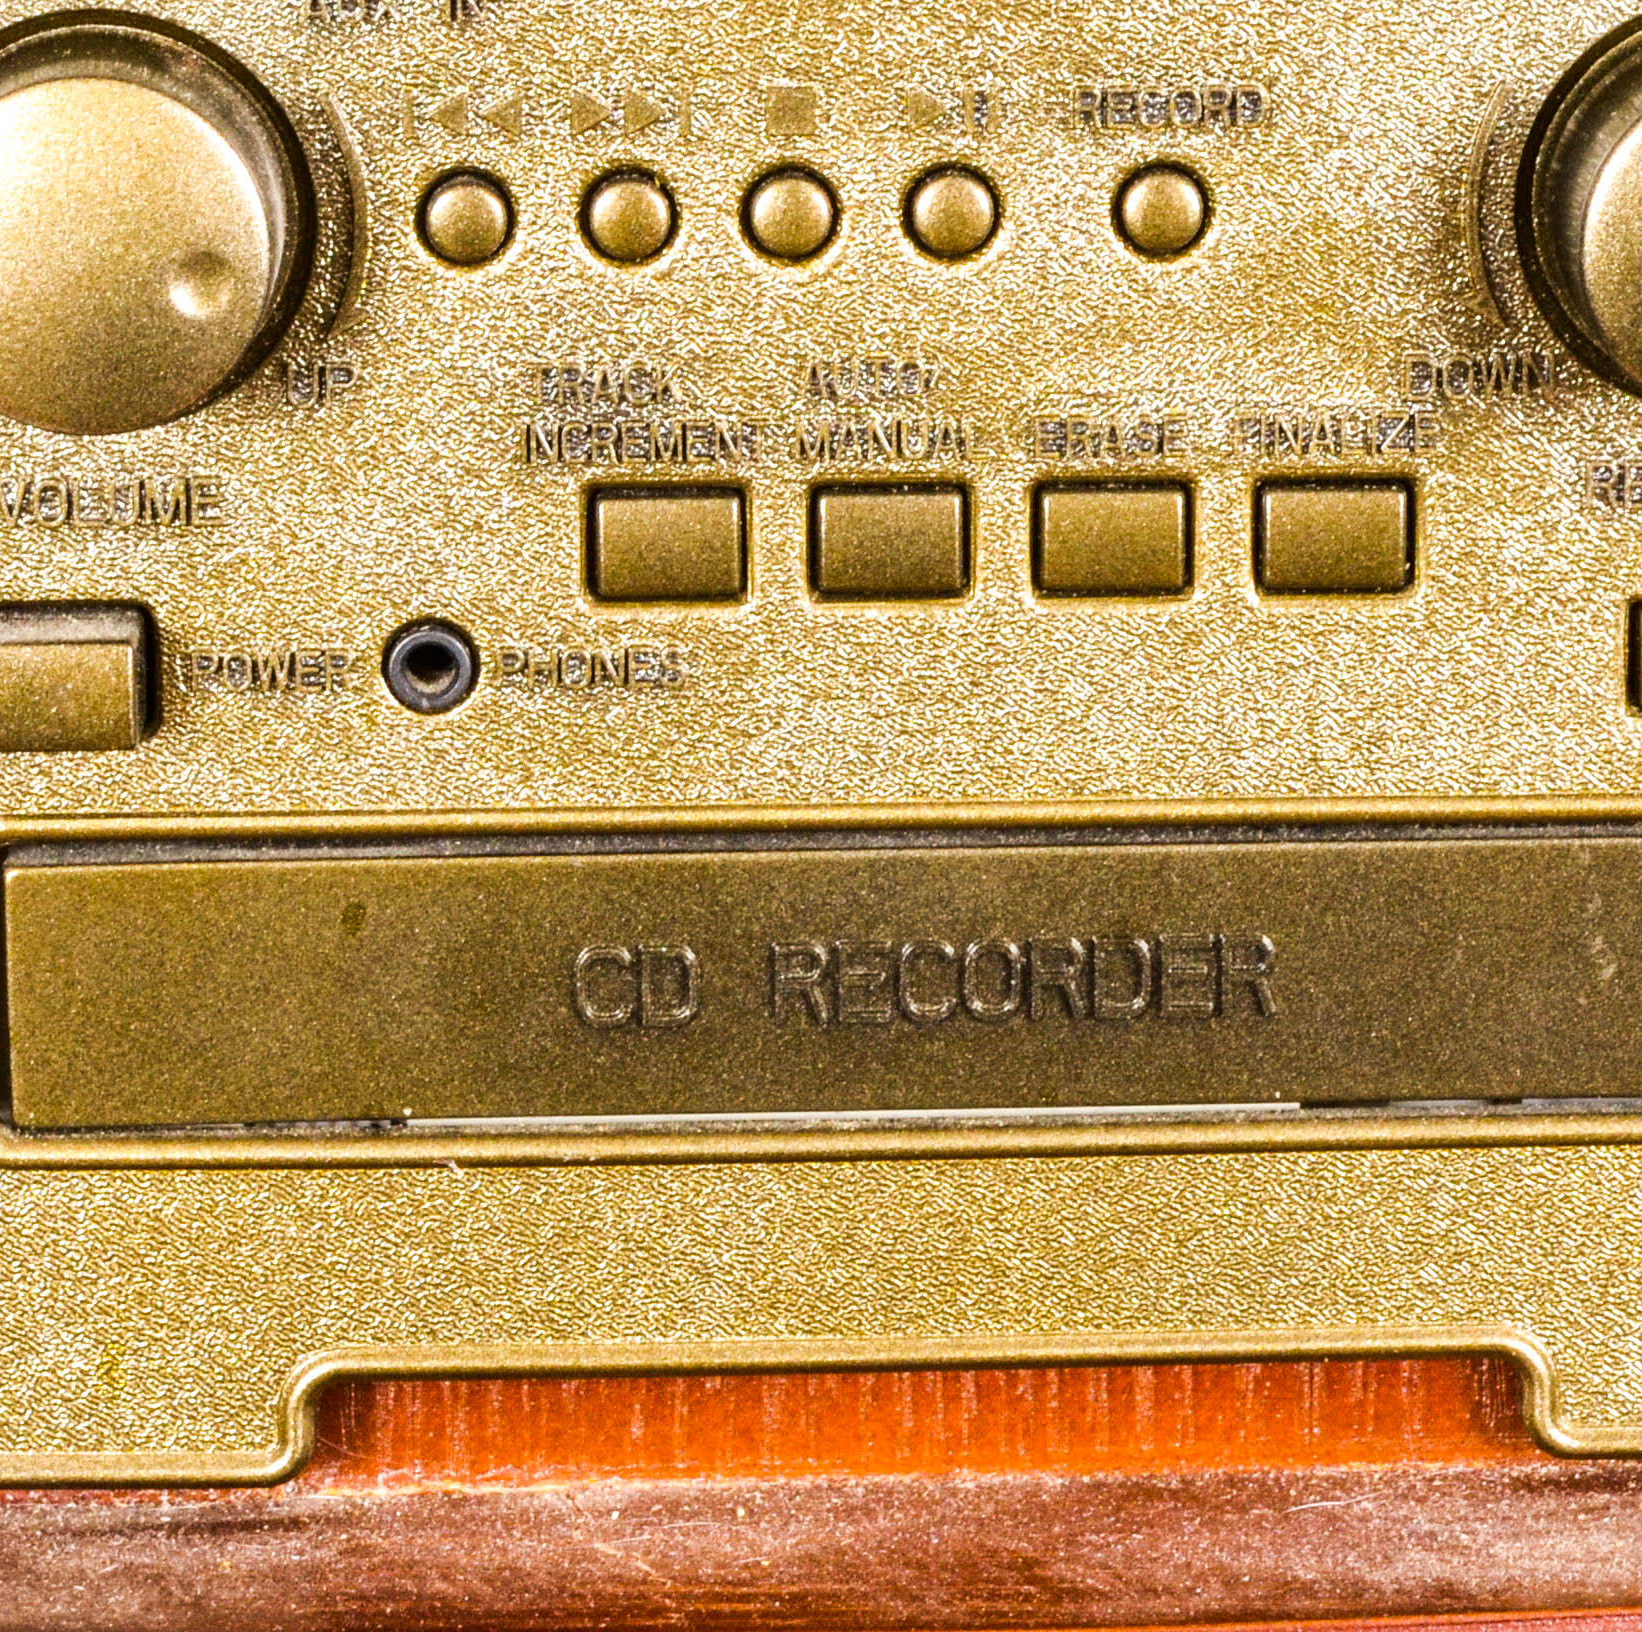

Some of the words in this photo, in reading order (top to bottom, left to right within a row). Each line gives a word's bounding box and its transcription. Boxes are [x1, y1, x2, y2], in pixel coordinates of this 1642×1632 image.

[1075, 85, 1273, 129] RECORD
[285, 368, 357, 407] UP
[520, 362, 687, 405] TRACK
[1402, 352, 1557, 401] DOWN
[794, 416, 1002, 461] MANUAL
[1035, 414, 1187, 458] ERASE
[1237, 411, 1439, 456] FINALIZE
[191, 650, 356, 691] POWER
[500, 646, 687, 689] PHONES
[573, 943, 699, 1029] CD
[770, 933, 1279, 1025] RECORDER
